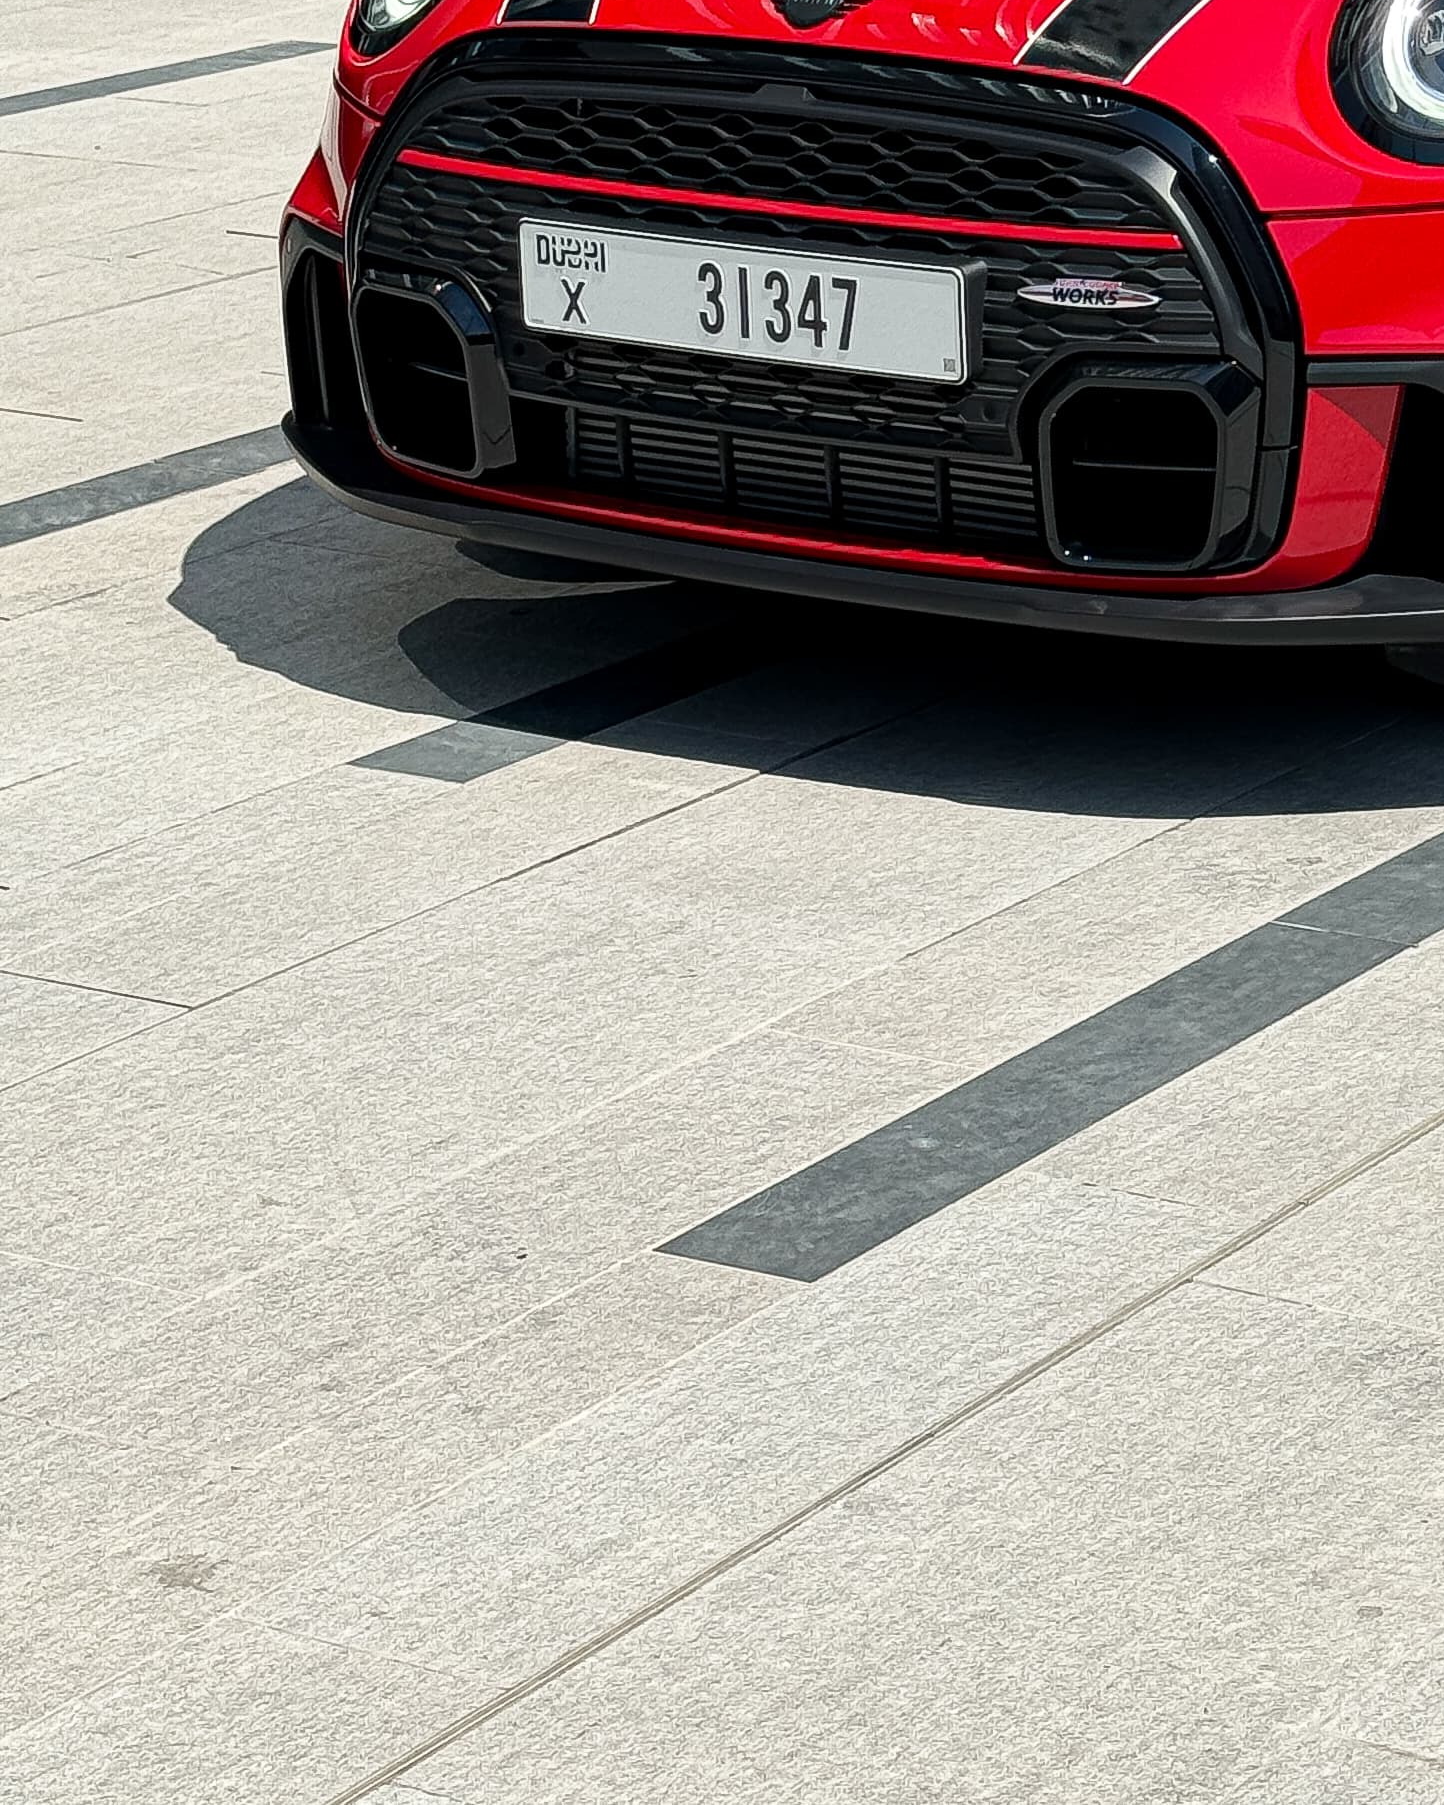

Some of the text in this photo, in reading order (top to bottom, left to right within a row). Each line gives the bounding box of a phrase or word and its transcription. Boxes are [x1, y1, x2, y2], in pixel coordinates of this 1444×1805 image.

[560, 278, 588, 324] X
[698, 262, 859, 351] 31347
[1052, 287, 1119, 306] WORKS
